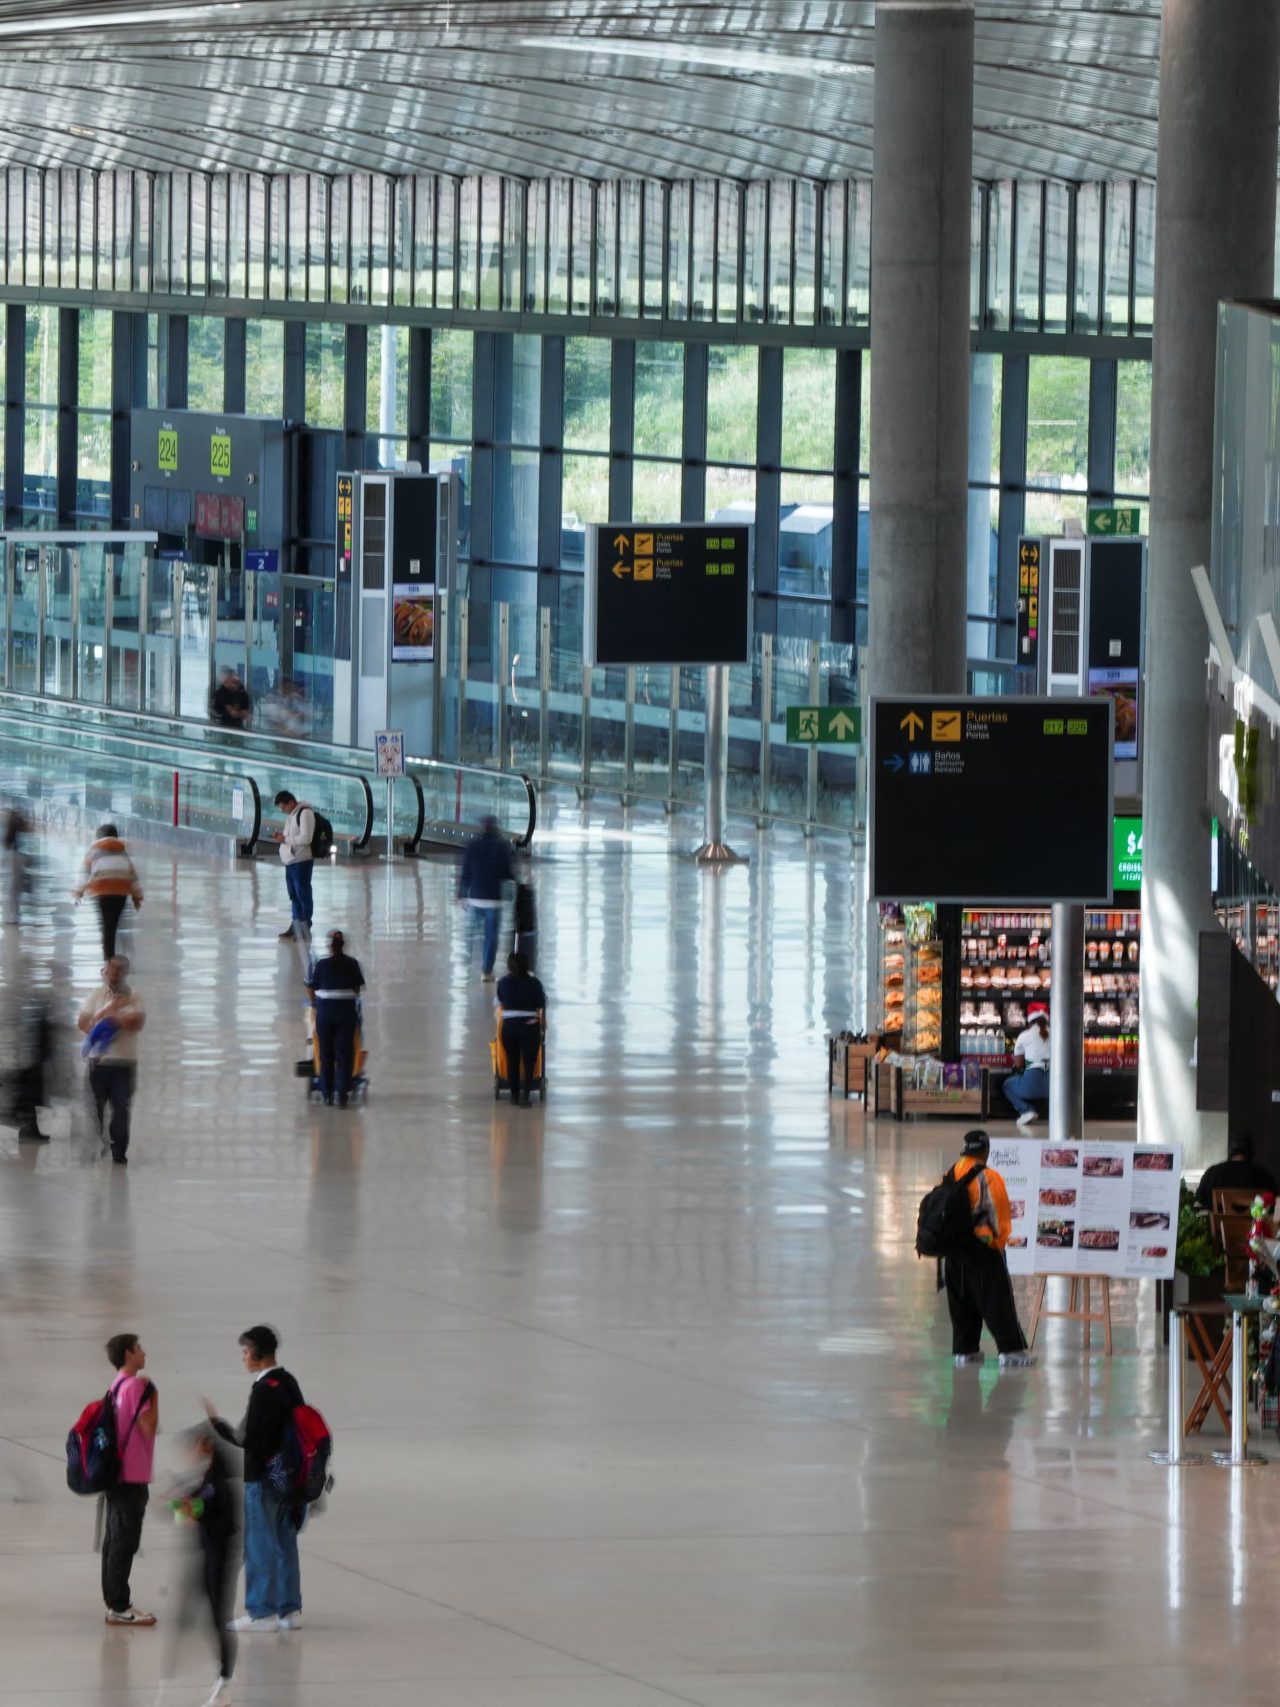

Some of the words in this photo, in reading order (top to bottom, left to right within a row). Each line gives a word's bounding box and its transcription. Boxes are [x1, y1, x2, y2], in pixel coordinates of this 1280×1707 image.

[159, 438, 176, 463] 224
[212, 442, 230, 469] 225
[656, 533, 684, 541] Puertas
[258, 559, 265, 570] 2
[656, 559, 683, 567] Puertas
[966, 711, 1008, 723] Puertas
[966, 723, 988, 731] Gates
[935, 752, 961, 761] Baños
[1118, 862, 1143, 873] CROISS
[984, 1057, 1007, 1065] GRATIS
[1088, 1057, 1113, 1065] GRATIS
[992, 1158, 1020, 1167] Garden
